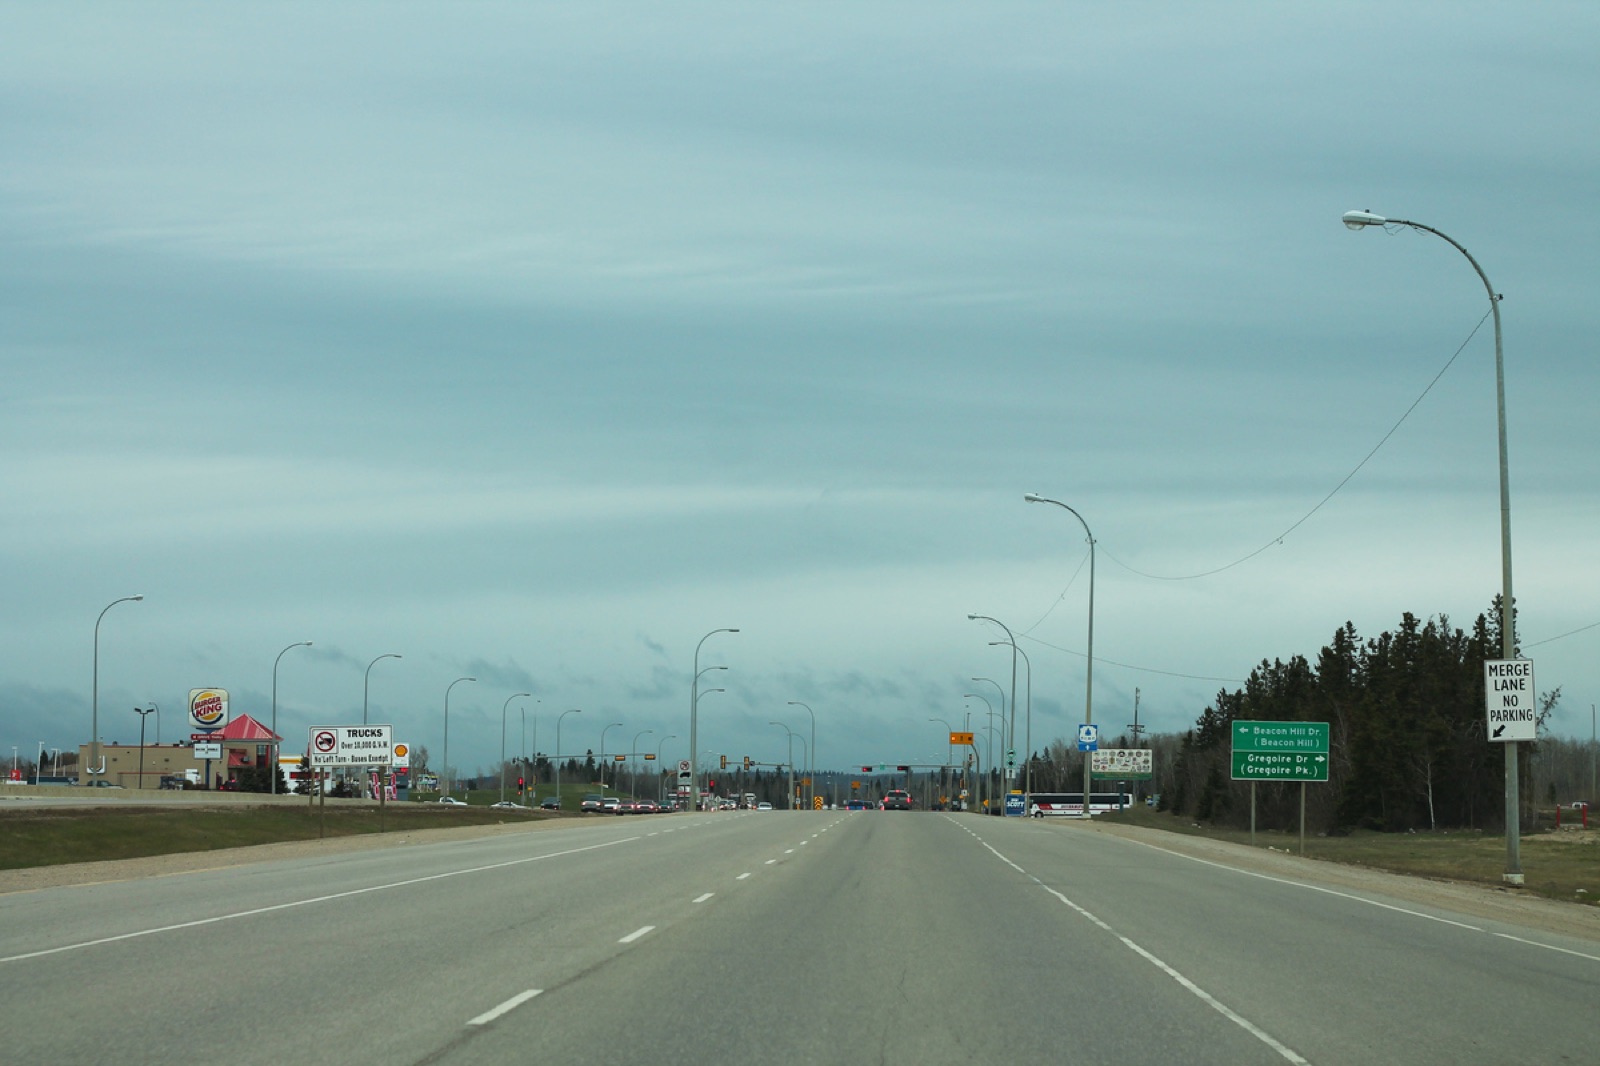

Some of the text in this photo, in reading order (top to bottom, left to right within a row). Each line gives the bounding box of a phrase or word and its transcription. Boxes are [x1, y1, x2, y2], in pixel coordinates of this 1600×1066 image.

[1489, 663, 1530, 677] MERGE
[1494, 678, 1526, 691] LANE
[195, 697, 220, 709] BURGER
[1503, 694, 1518, 707] NO
[196, 703, 222, 718] KING
[1490, 708, 1533, 722] PARKING
[347, 729, 383, 738] TRUCKS
[1253, 726, 1288, 735] Beacon
[1290, 727, 1306, 735] Hill
[341, 741, 353, 749] Over
[322, 755, 334, 763] Left
[335, 755, 347, 763] Turn
[351, 755, 367, 763] Buses
[1247, 754, 1308, 764] Gregoire Dr
